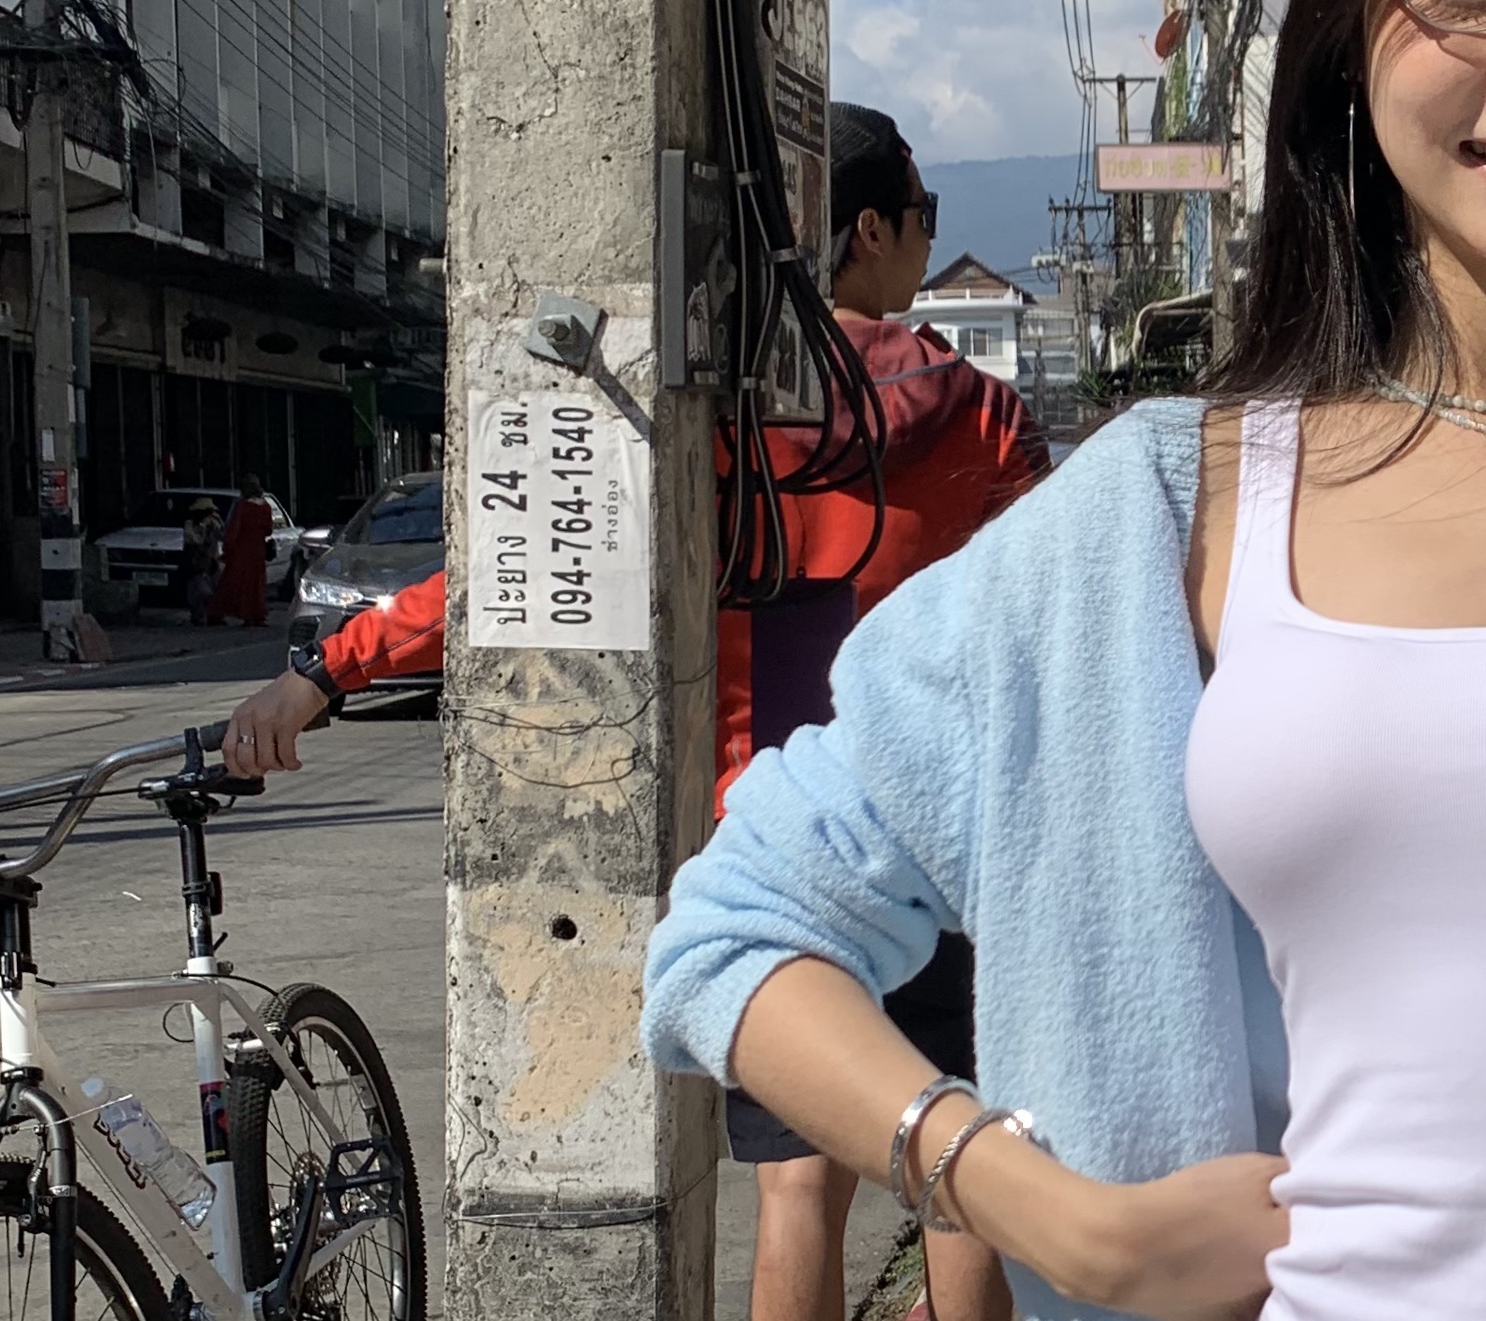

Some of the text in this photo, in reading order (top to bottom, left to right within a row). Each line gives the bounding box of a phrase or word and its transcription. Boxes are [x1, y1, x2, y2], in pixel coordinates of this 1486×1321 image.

[481, 401, 529, 625] ปะยาง 24 ชม.
[550, 406, 594, 625] 094-764-1540
